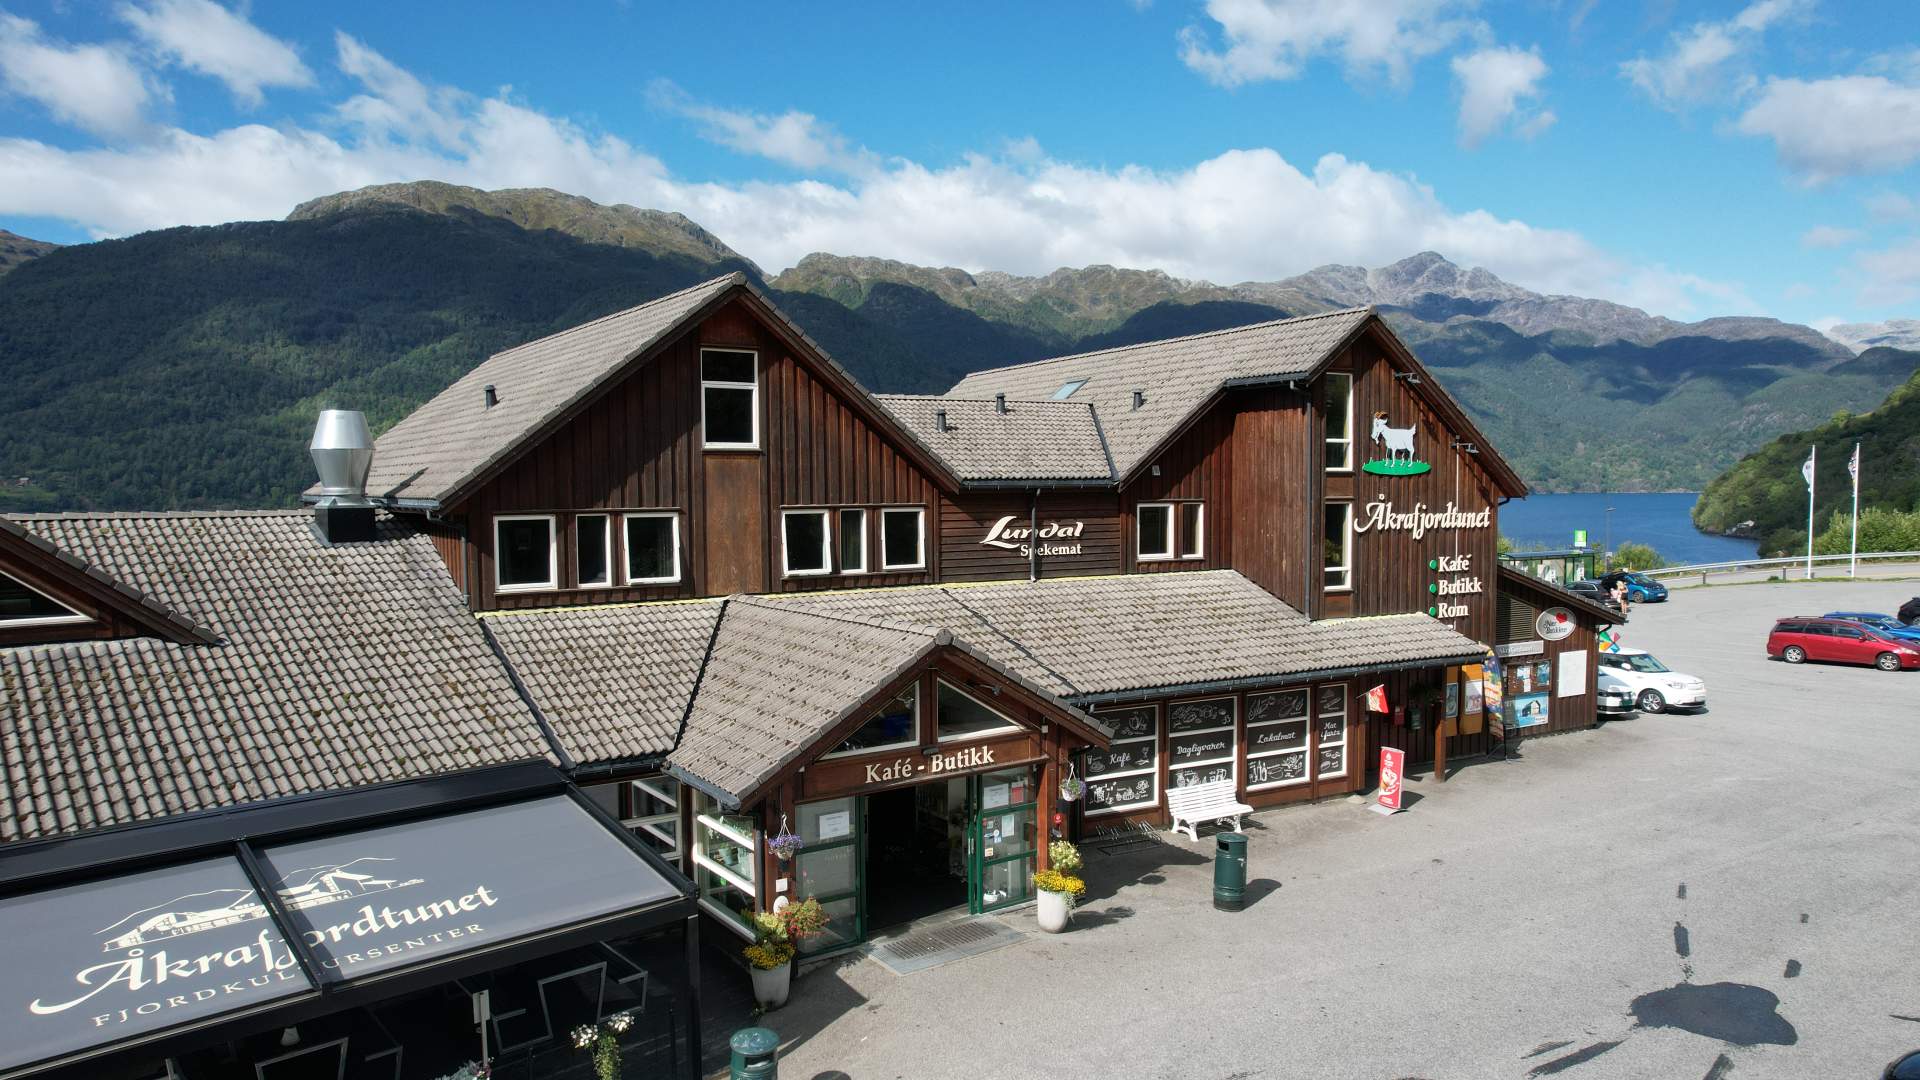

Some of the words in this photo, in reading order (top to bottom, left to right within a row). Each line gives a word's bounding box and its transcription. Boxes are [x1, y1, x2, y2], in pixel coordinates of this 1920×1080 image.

[1354, 494, 1490, 540] Åkrafjordtunet
[979, 515, 1084, 549] Lundal
[1438, 554, 1472, 573] Kafé
[1438, 577, 1483, 596] Butikk
[1437, 602, 1470, 619] Rom
[1257, 731, 1297, 744] Lokalmat
[865, 757, 912, 784] Kafé
[931, 745, 995, 773] Butikk
[91, 923, 485, 1028] FJORDKULURSENTER
